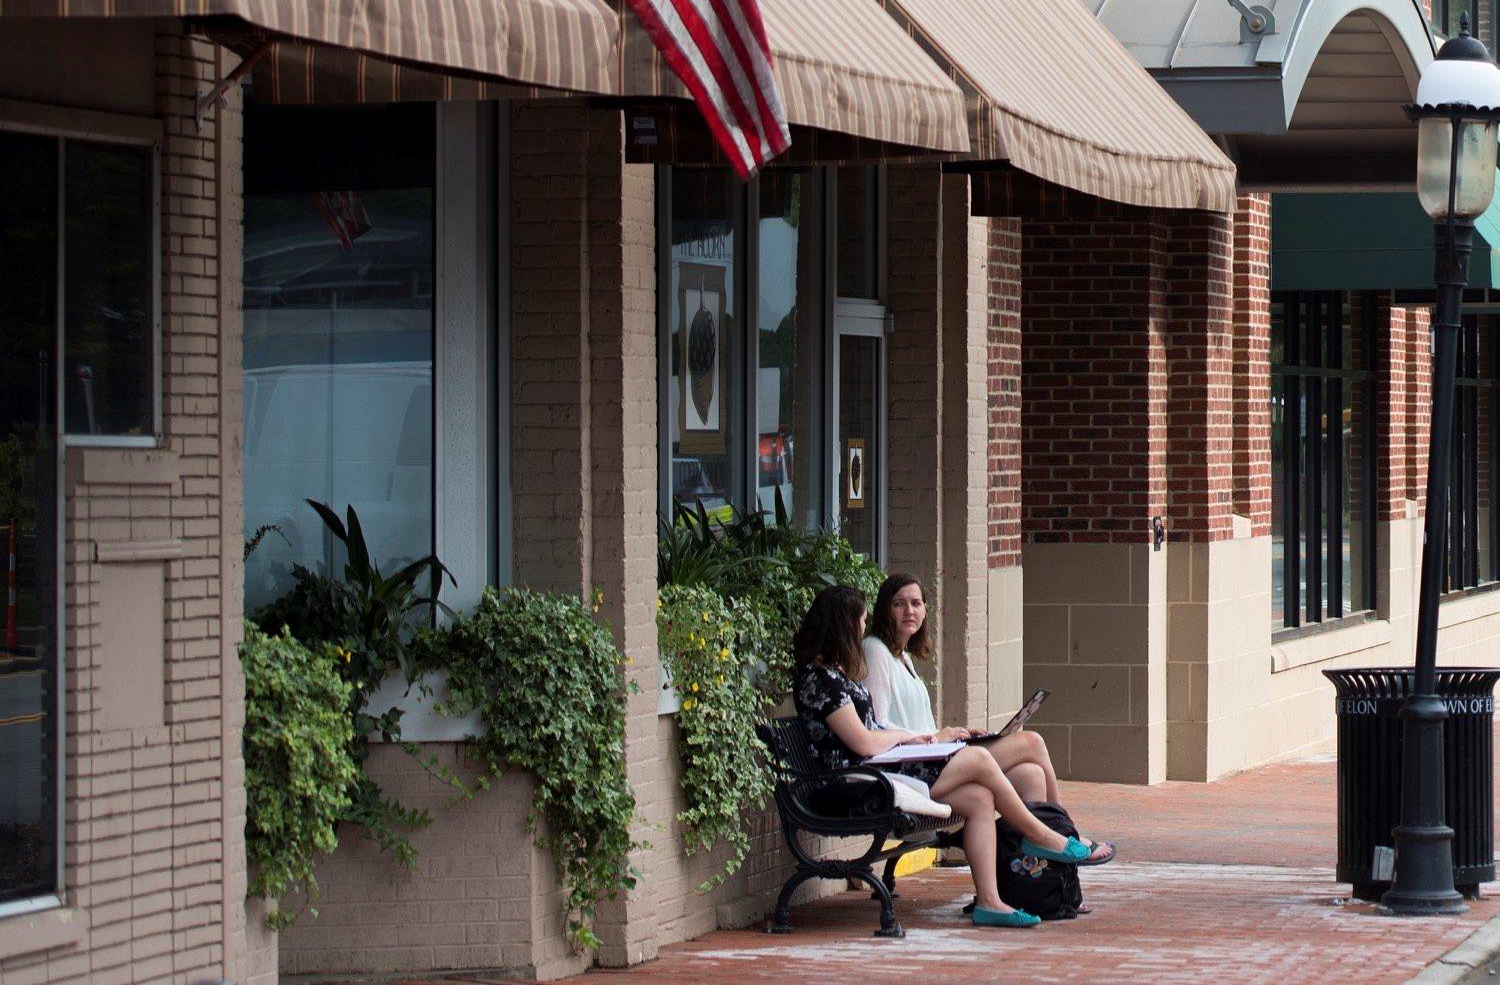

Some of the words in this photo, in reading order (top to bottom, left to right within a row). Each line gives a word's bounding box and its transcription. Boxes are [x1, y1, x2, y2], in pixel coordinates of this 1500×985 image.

[1347, 700, 1377, 714] ELON
[1443, 699, 1467, 714] WN
[1470, 699, 1484, 714] OF
